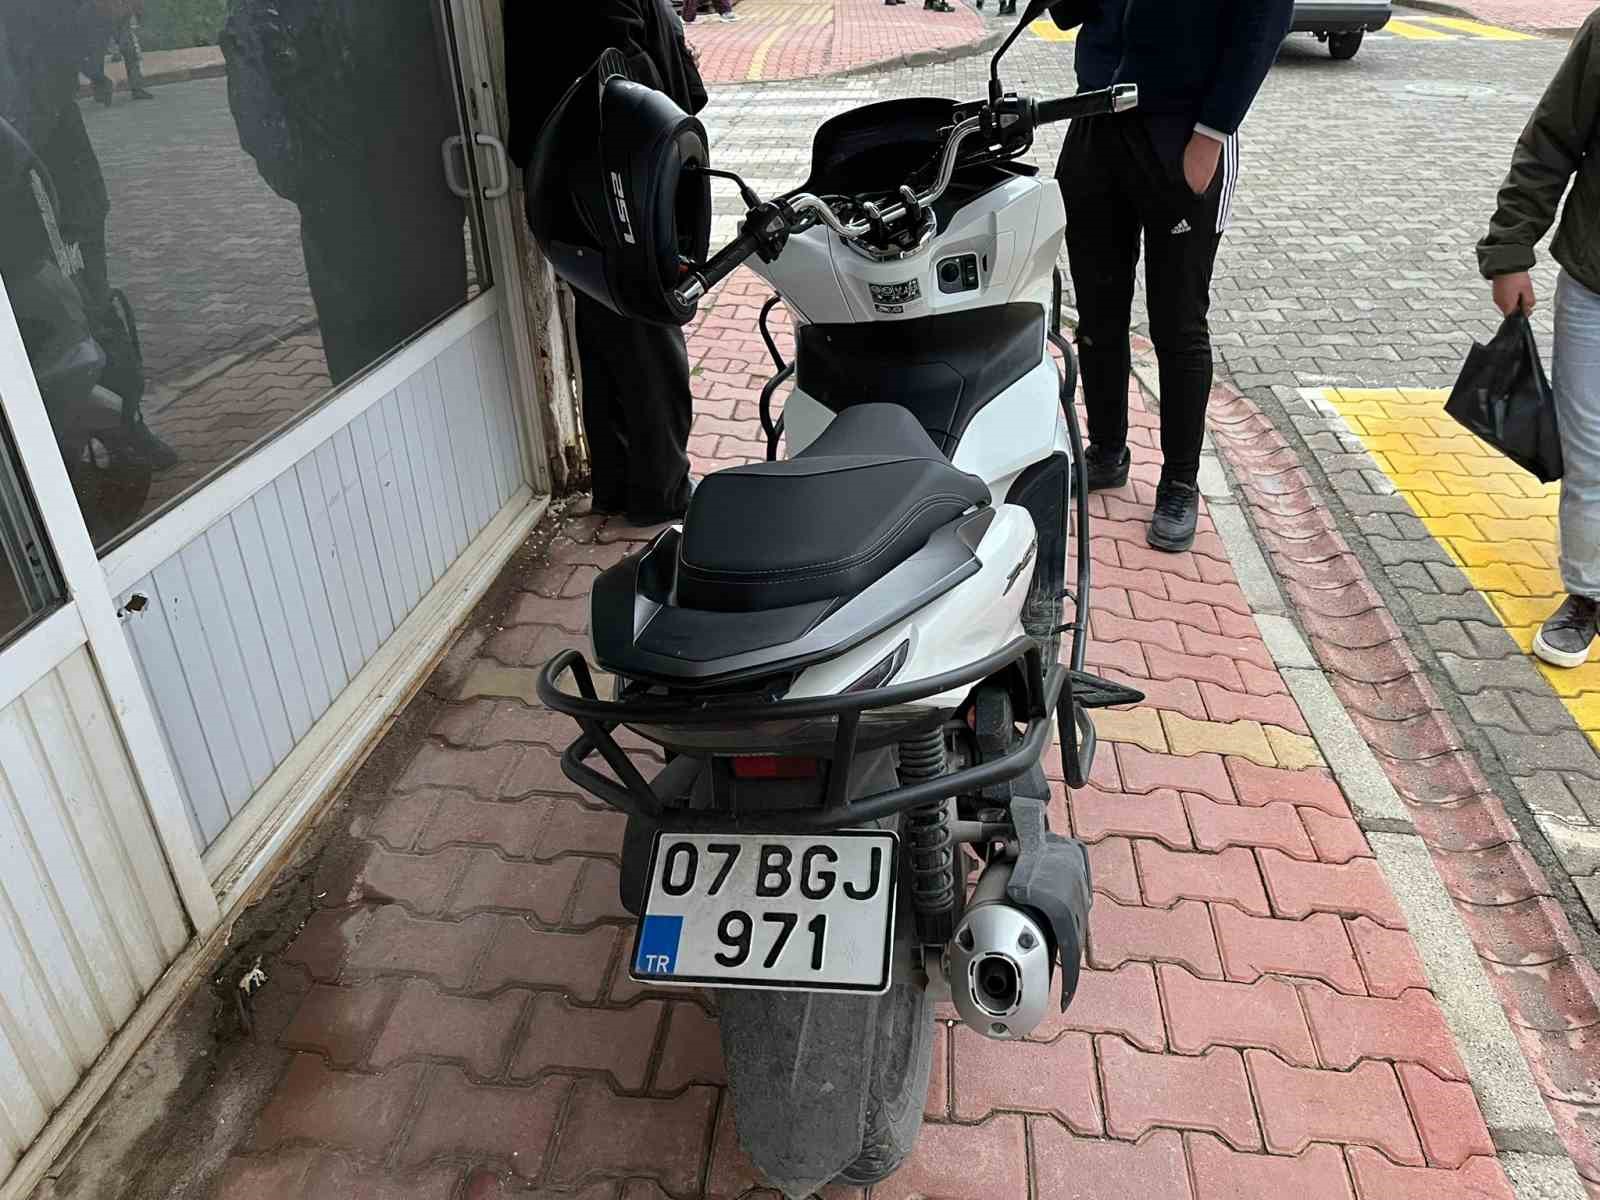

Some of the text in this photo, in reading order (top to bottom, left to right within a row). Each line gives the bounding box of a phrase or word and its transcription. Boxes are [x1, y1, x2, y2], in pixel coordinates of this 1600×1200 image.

[610, 171, 636, 244] LS2
[661, 842, 882, 901] 07 BGJ
[645, 954, 670, 972] TR
[714, 910, 827, 970] 971
